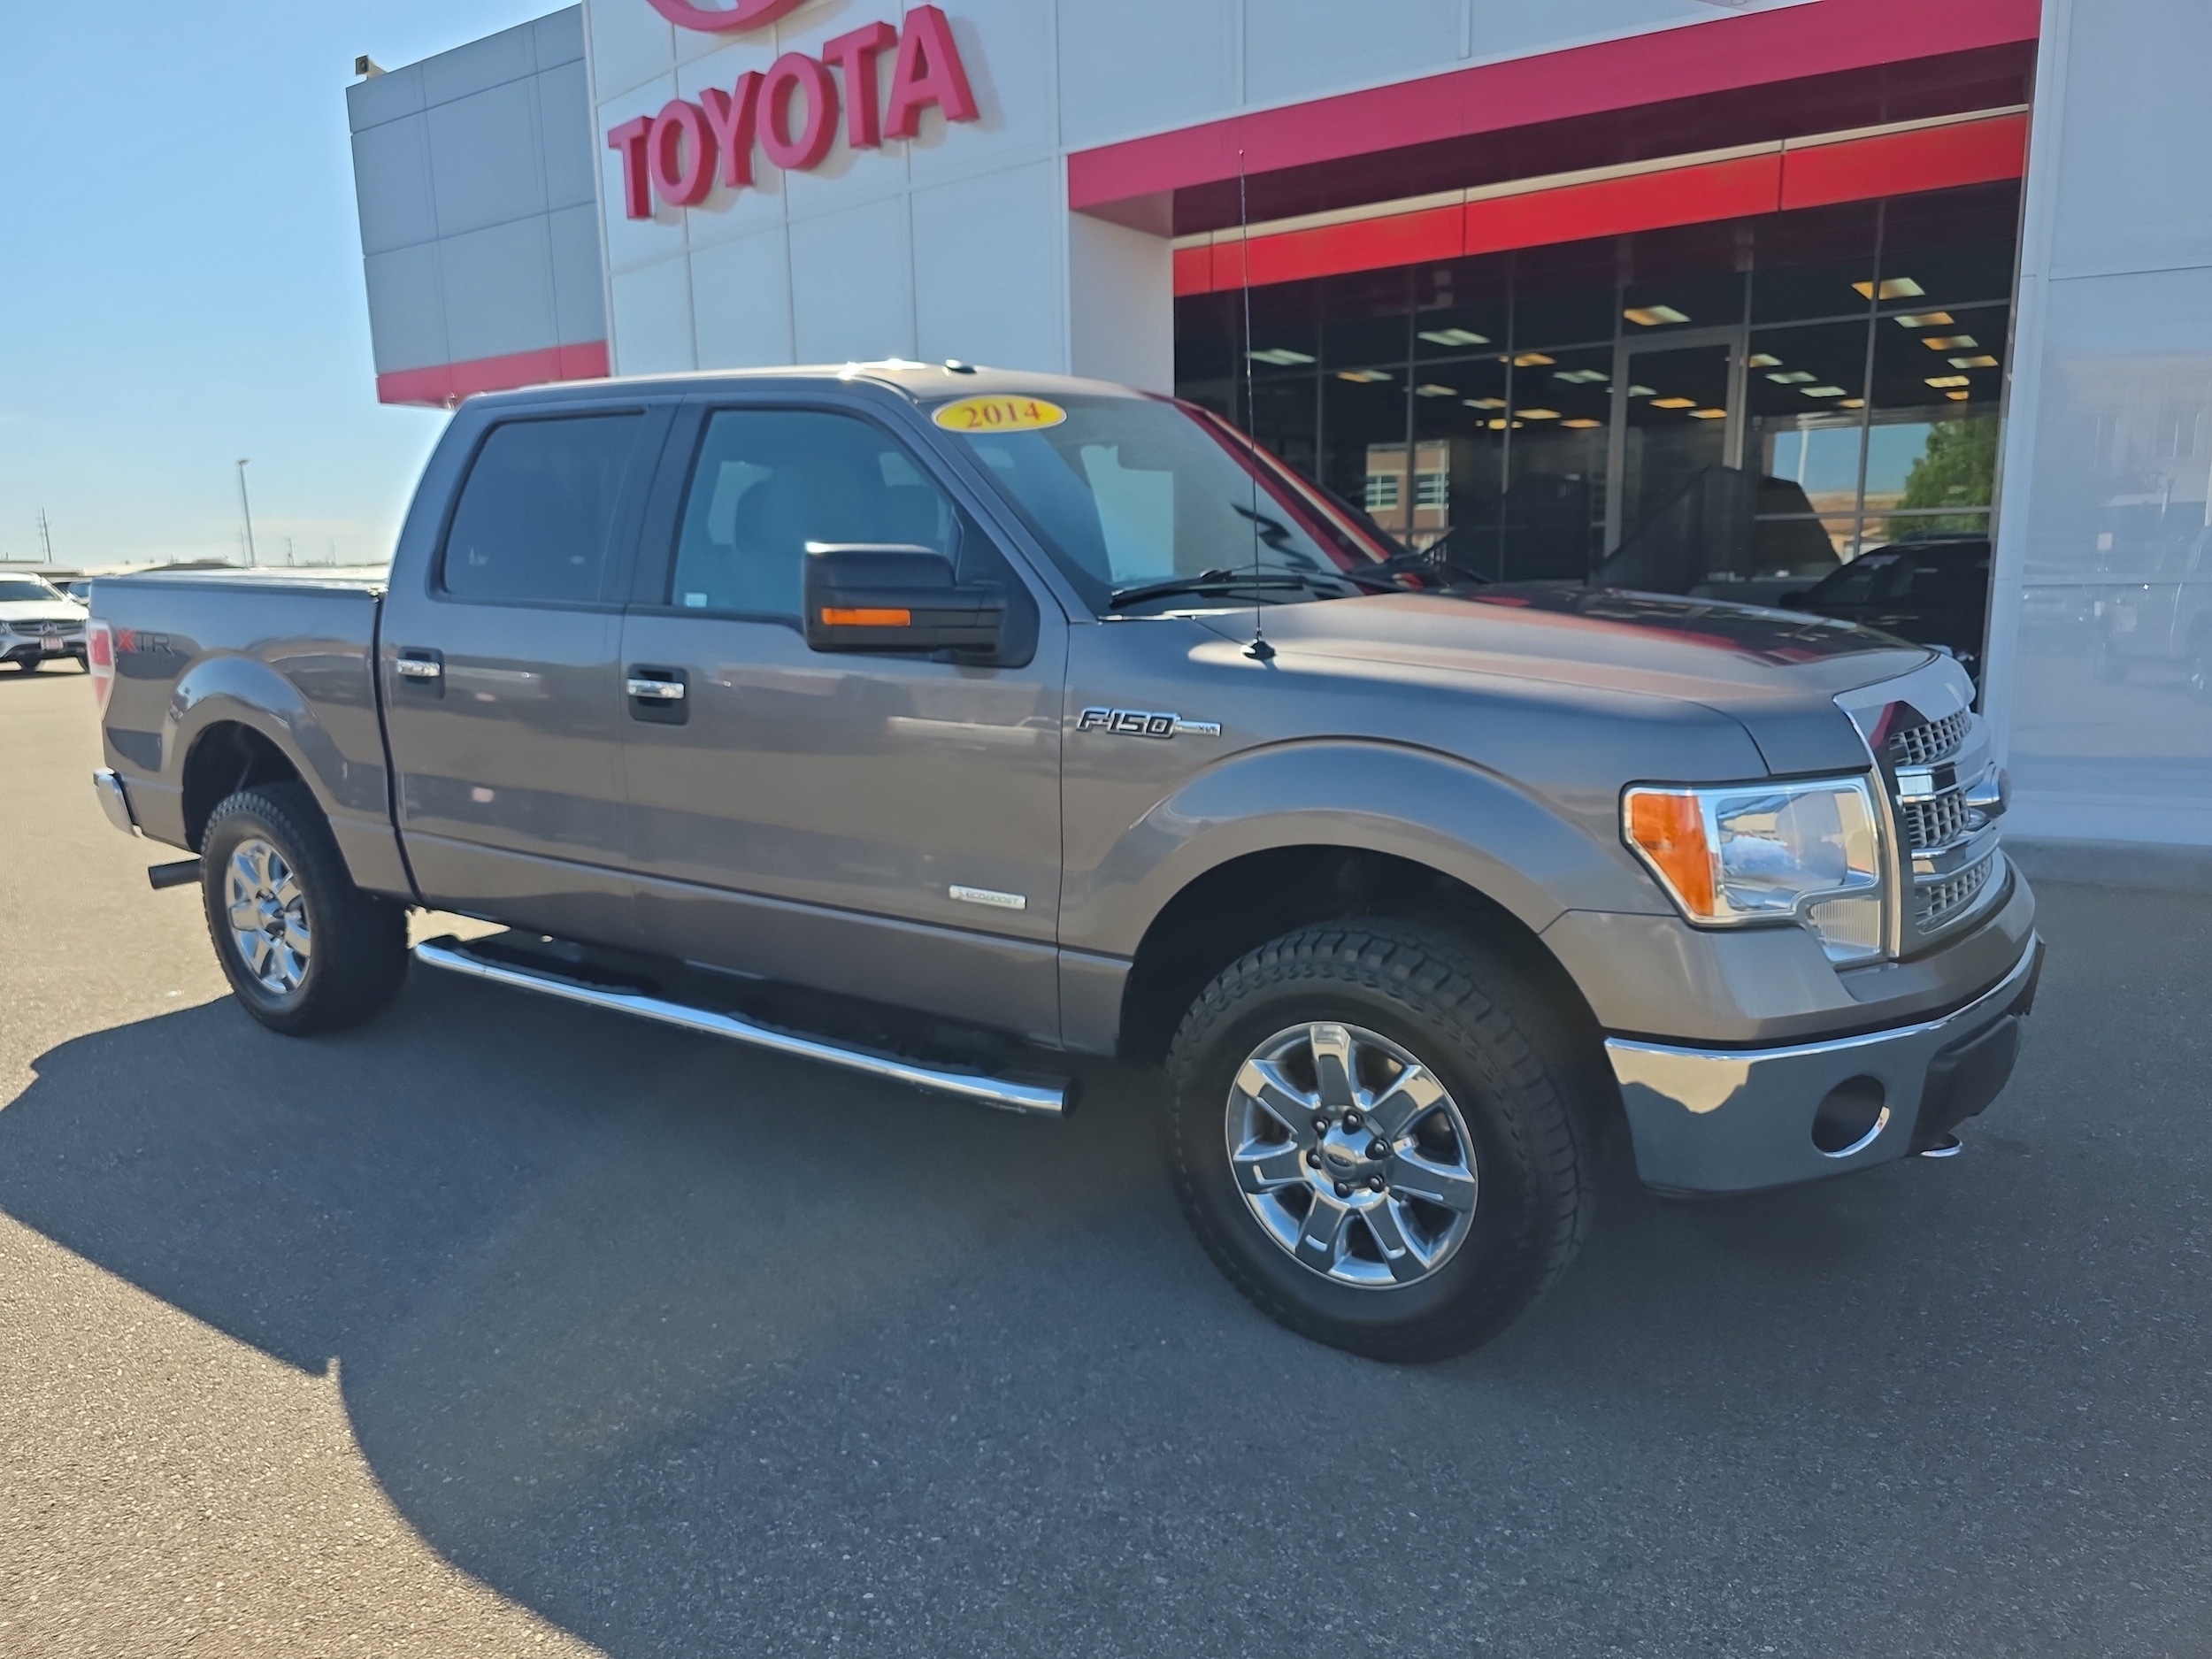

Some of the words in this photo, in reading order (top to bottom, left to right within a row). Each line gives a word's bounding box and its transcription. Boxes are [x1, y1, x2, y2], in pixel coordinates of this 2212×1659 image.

[608, 4, 979, 220] TOYOTA
[963, 402, 1041, 429] 2014
[117, 628, 175, 657] XTR
